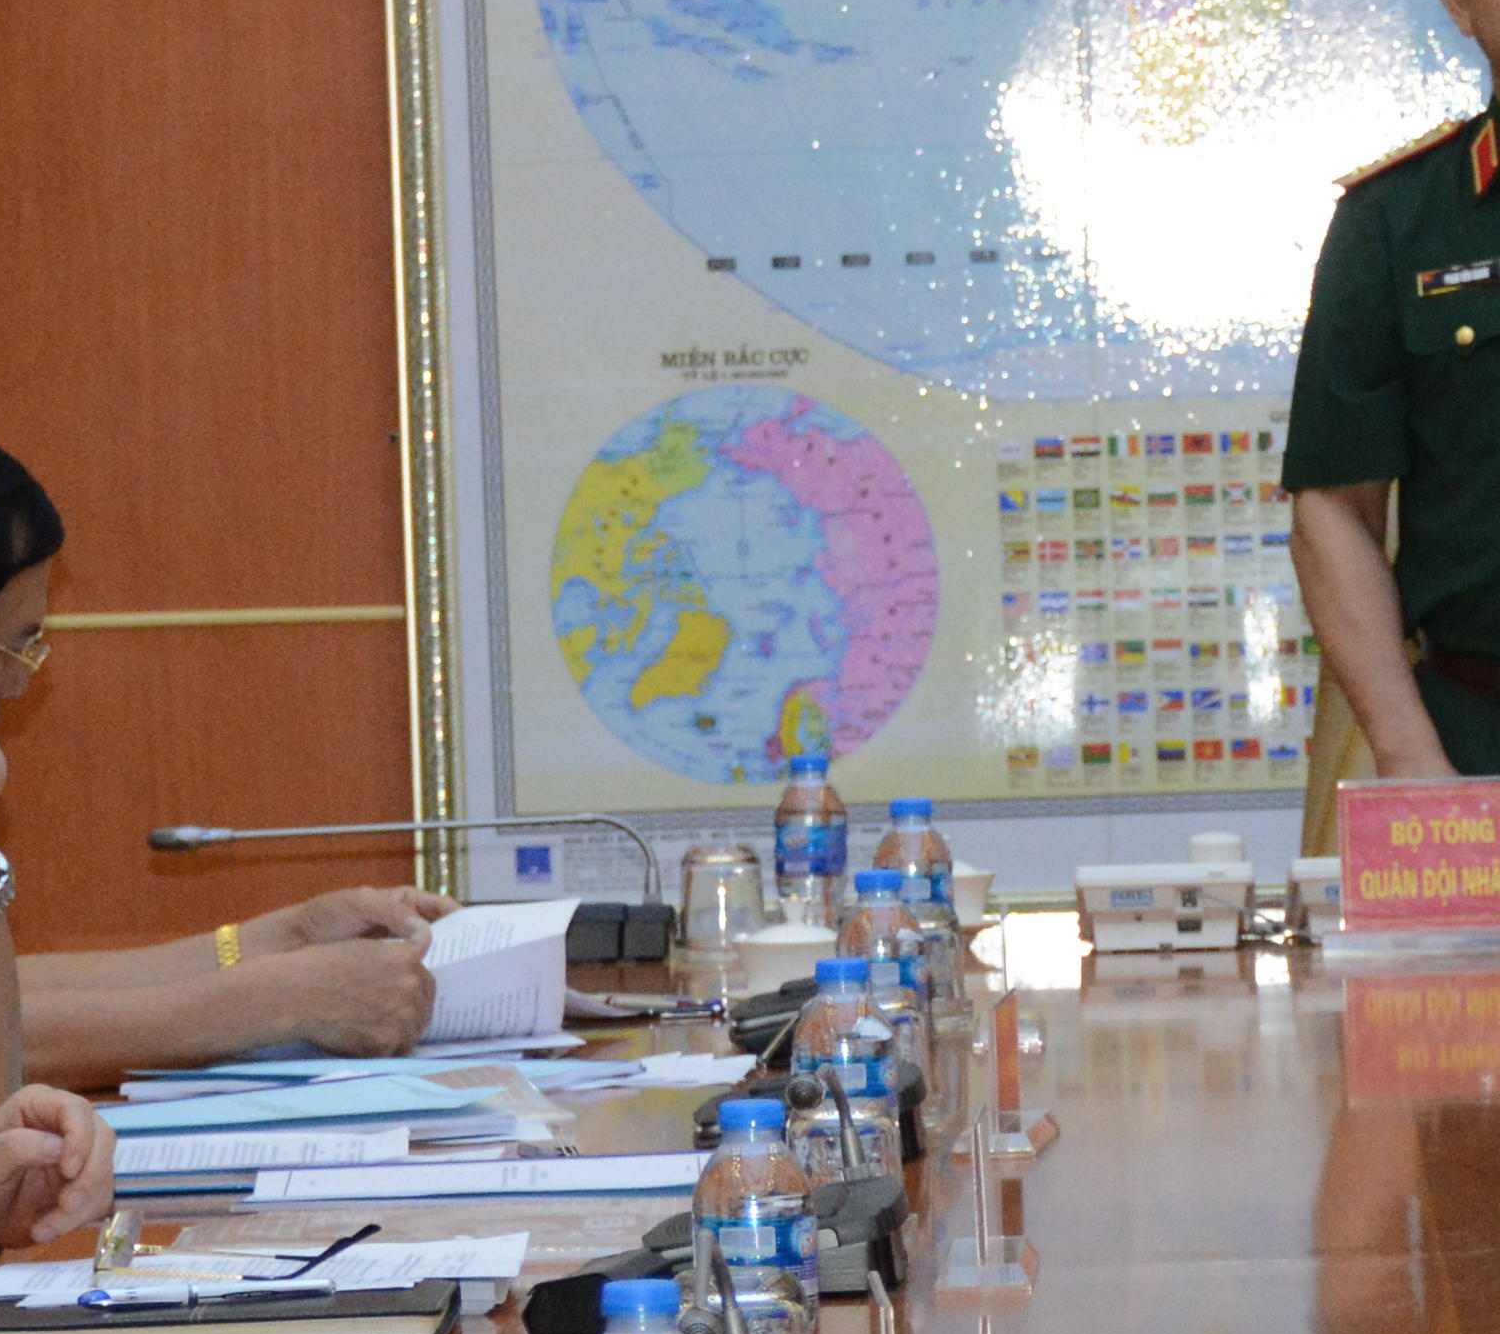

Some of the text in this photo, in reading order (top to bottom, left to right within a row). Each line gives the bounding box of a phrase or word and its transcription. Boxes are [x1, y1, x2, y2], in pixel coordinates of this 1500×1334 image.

[1391, 816, 1423, 853] BỘ
[1430, 805, 1496, 844] TỔNG
[1360, 861, 1418, 899] QUÂN
